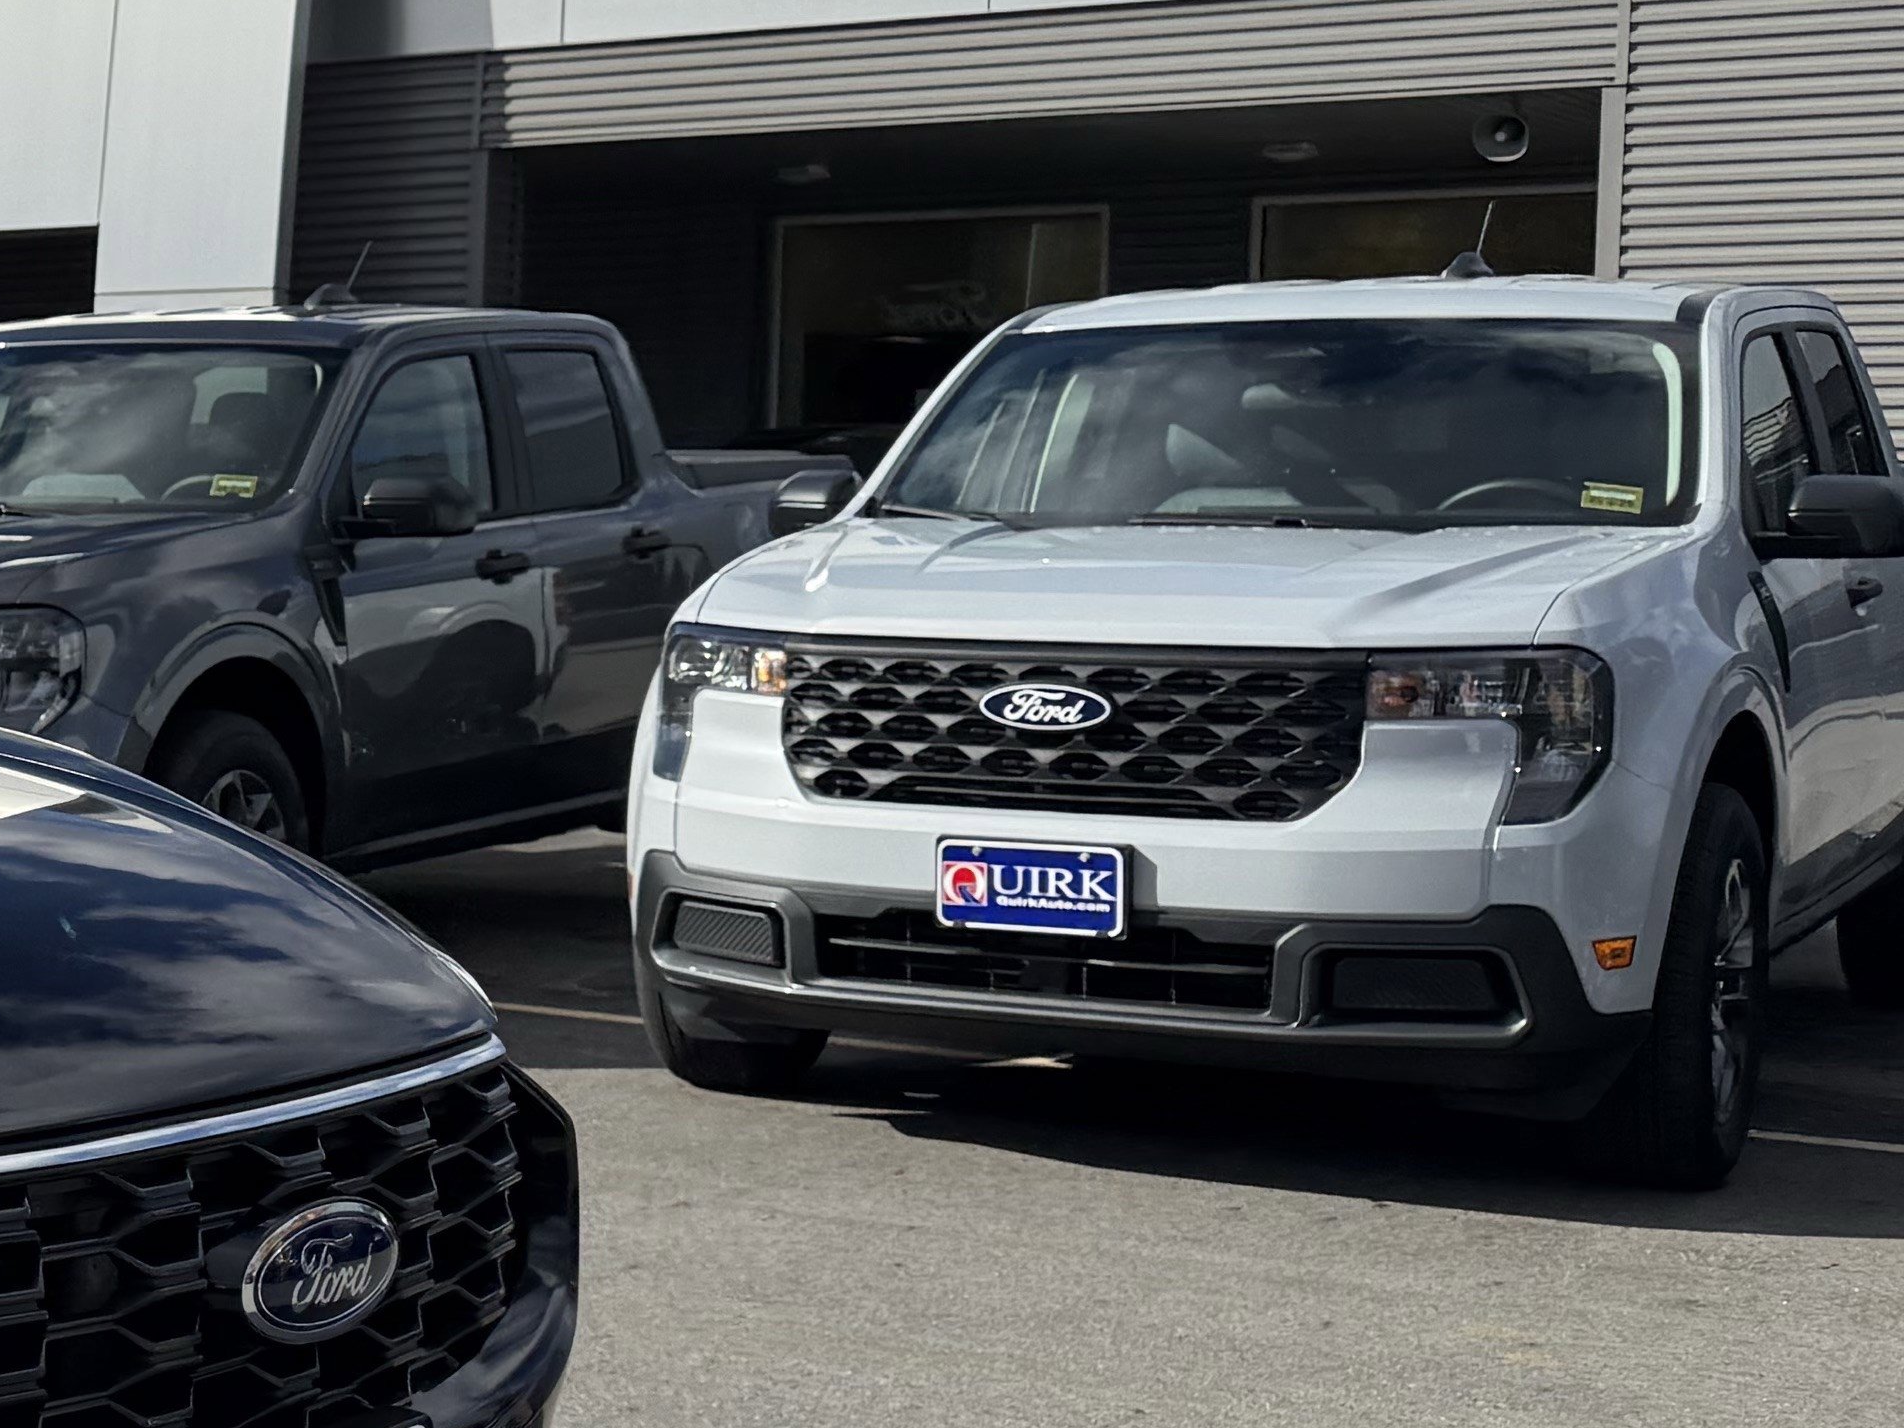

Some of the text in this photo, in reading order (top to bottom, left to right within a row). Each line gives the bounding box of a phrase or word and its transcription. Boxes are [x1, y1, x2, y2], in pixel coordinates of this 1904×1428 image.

[1003, 689, 1086, 723] Ford
[943, 863, 1116, 905] QUIRK
[995, 895, 1111, 913] QuirkAuto.com
[291, 1233, 373, 1313] Ford
